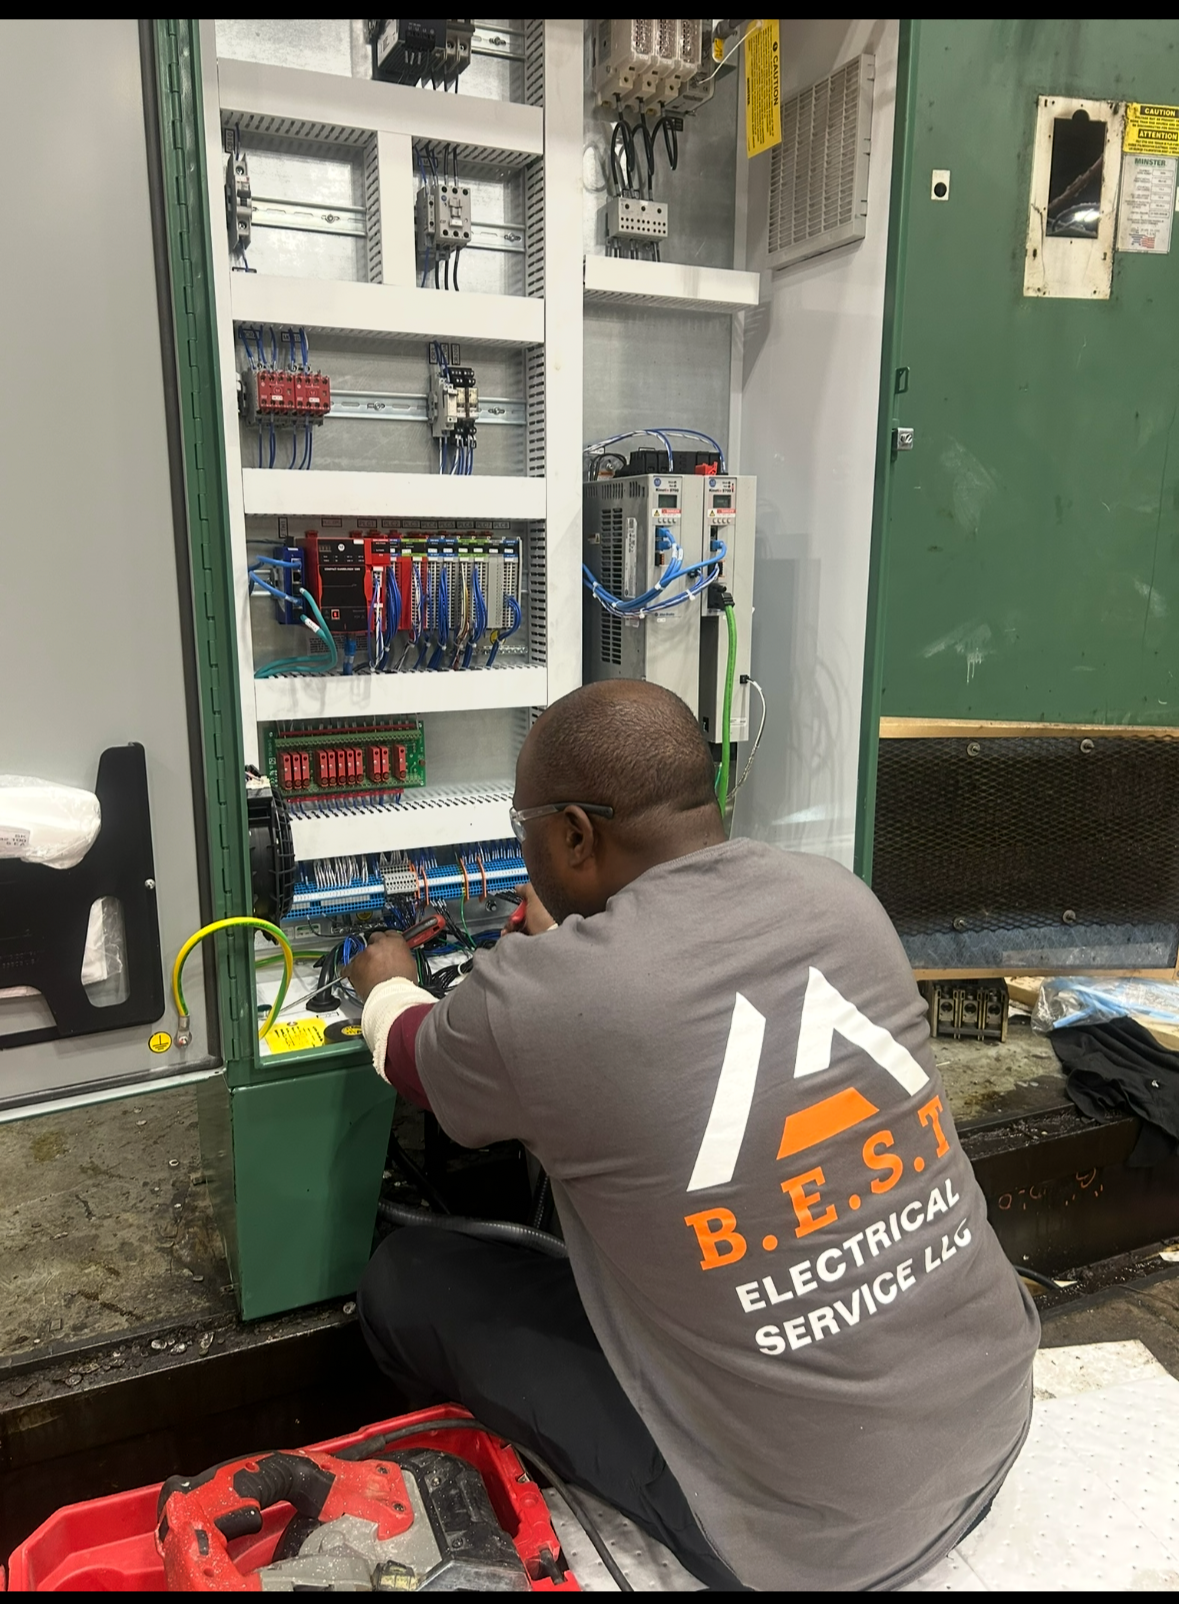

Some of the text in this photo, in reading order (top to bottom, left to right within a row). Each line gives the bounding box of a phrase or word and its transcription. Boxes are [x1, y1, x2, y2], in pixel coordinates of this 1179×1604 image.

[1144, 107, 1176, 117] CAUTION
[1139, 130, 1178, 140] ATTENTION
[1134, 157, 1166, 166] MINSTER
[736, 1178, 960, 1312] ELECTRICAL
[755, 1217, 972, 1355] SERVICE LLC
